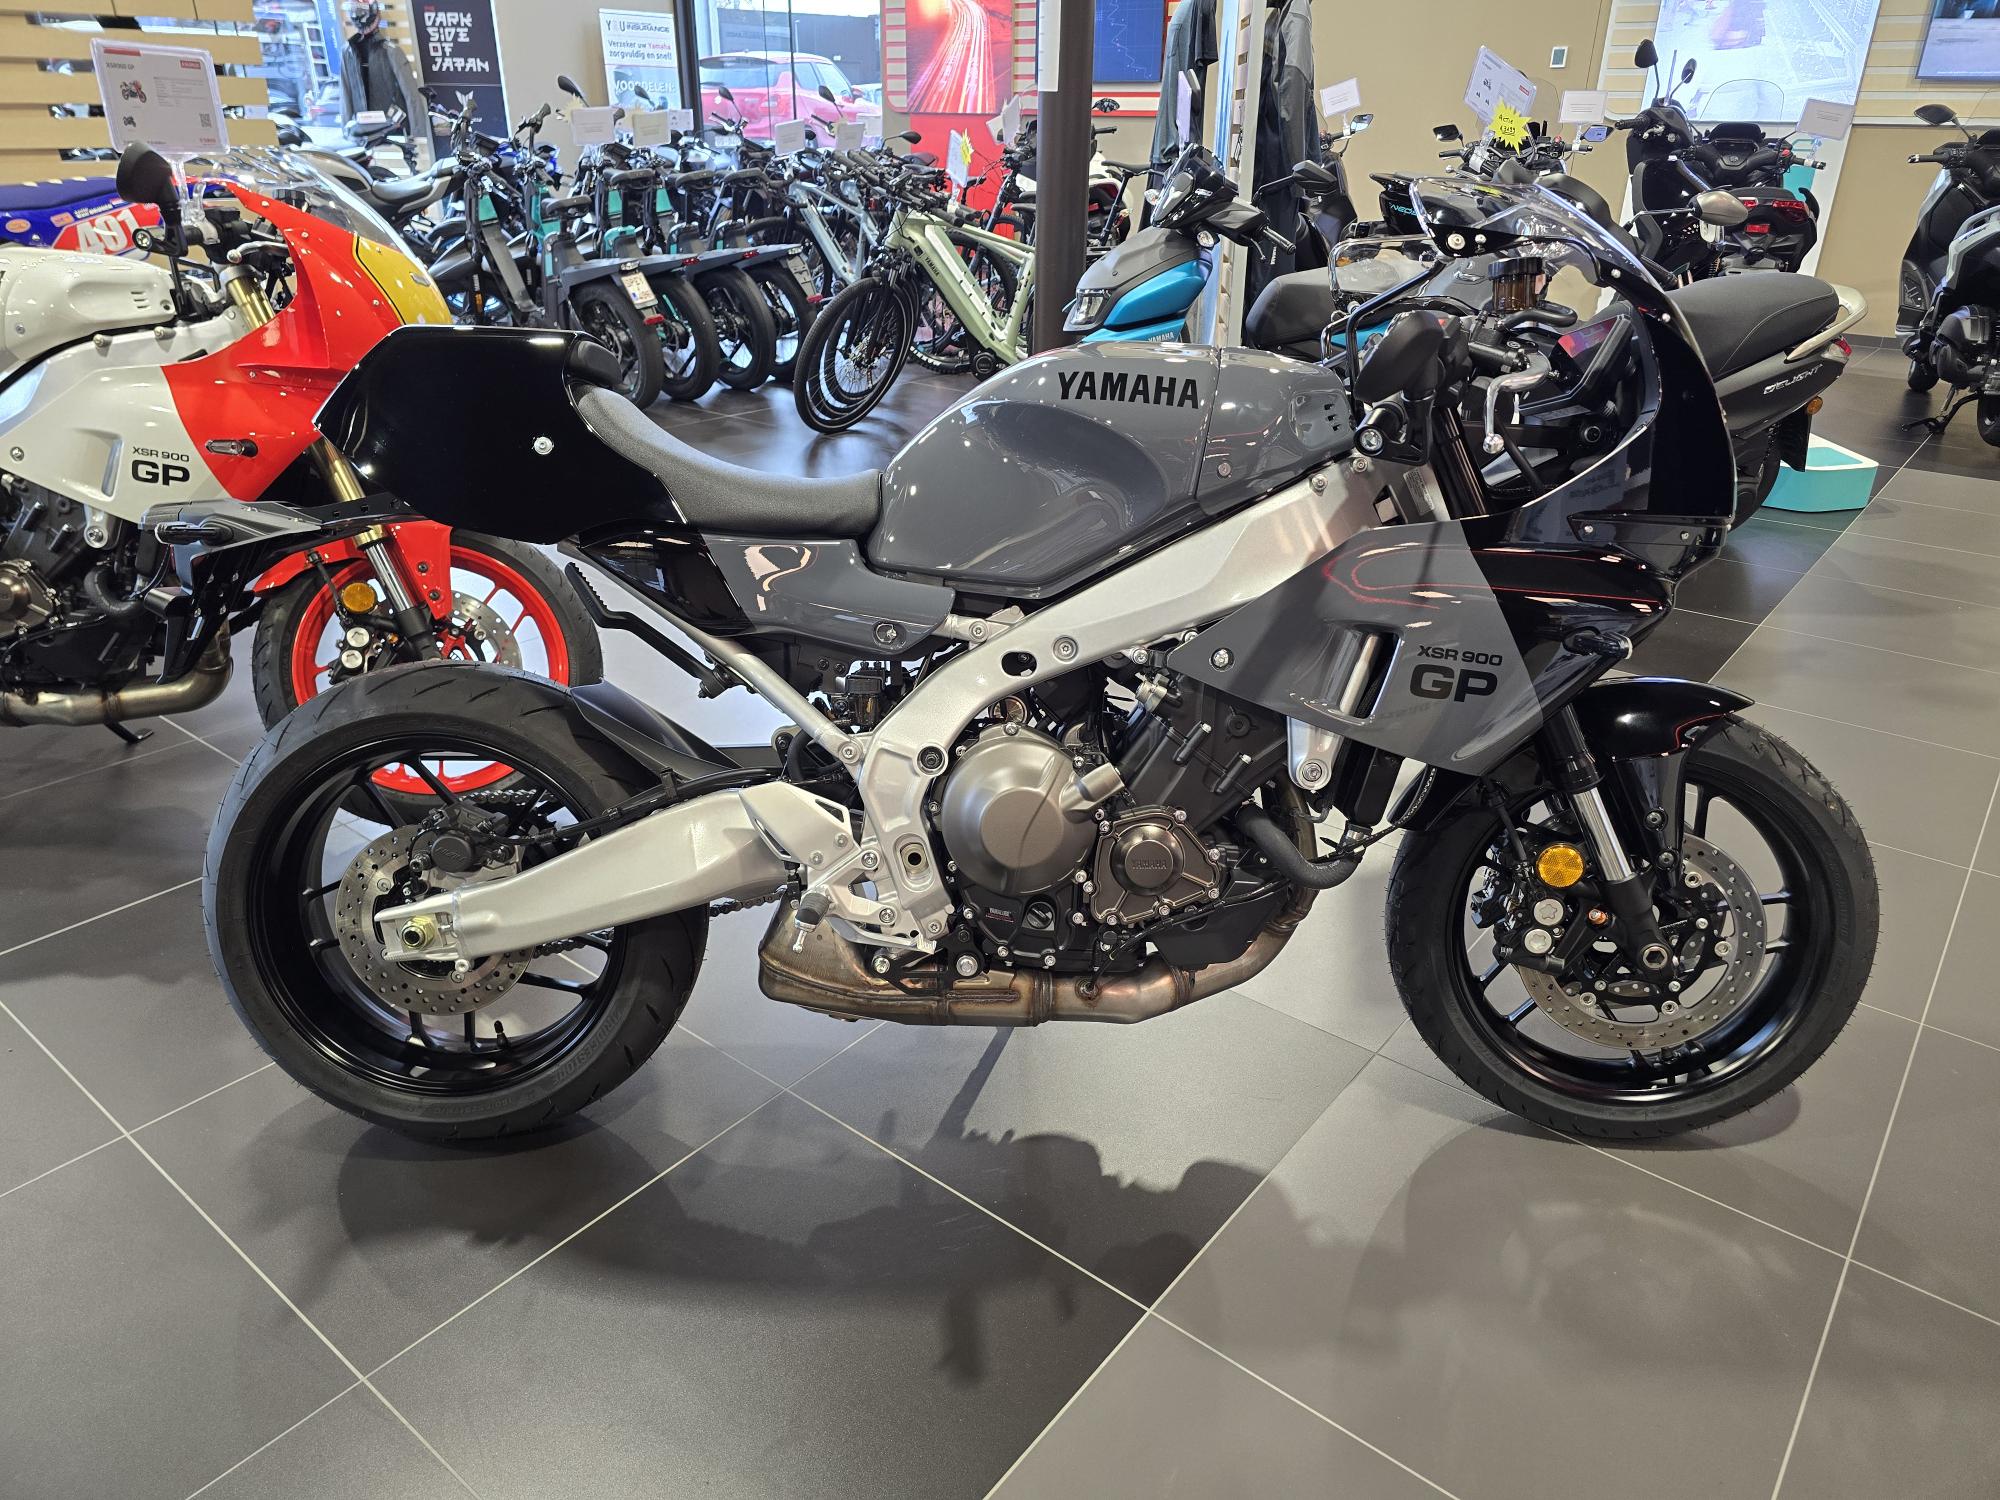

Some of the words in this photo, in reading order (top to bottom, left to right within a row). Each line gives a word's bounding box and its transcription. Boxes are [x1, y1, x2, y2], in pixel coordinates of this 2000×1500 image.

[424, 12, 472, 27] DARK
[426, 27, 470, 42] SIDE
[428, 42, 453, 56] OF
[608, 40, 636, 48] Verzeker
[609, 51, 645, 60] zorgvuldig
[432, 57, 490, 72] JAPAN
[925, 257, 940, 277] YAMAHA
[1148, 332, 1175, 342] YAMAHA
[1058, 371, 1199, 409] YAMAHA
[132, 446, 159, 458] XSR
[161, 451, 190, 462] 900
[132, 460, 190, 487] GP
[1417, 645, 1459, 661] XSR
[1461, 651, 1503, 666] 900
[1410, 664, 1498, 702] GP
